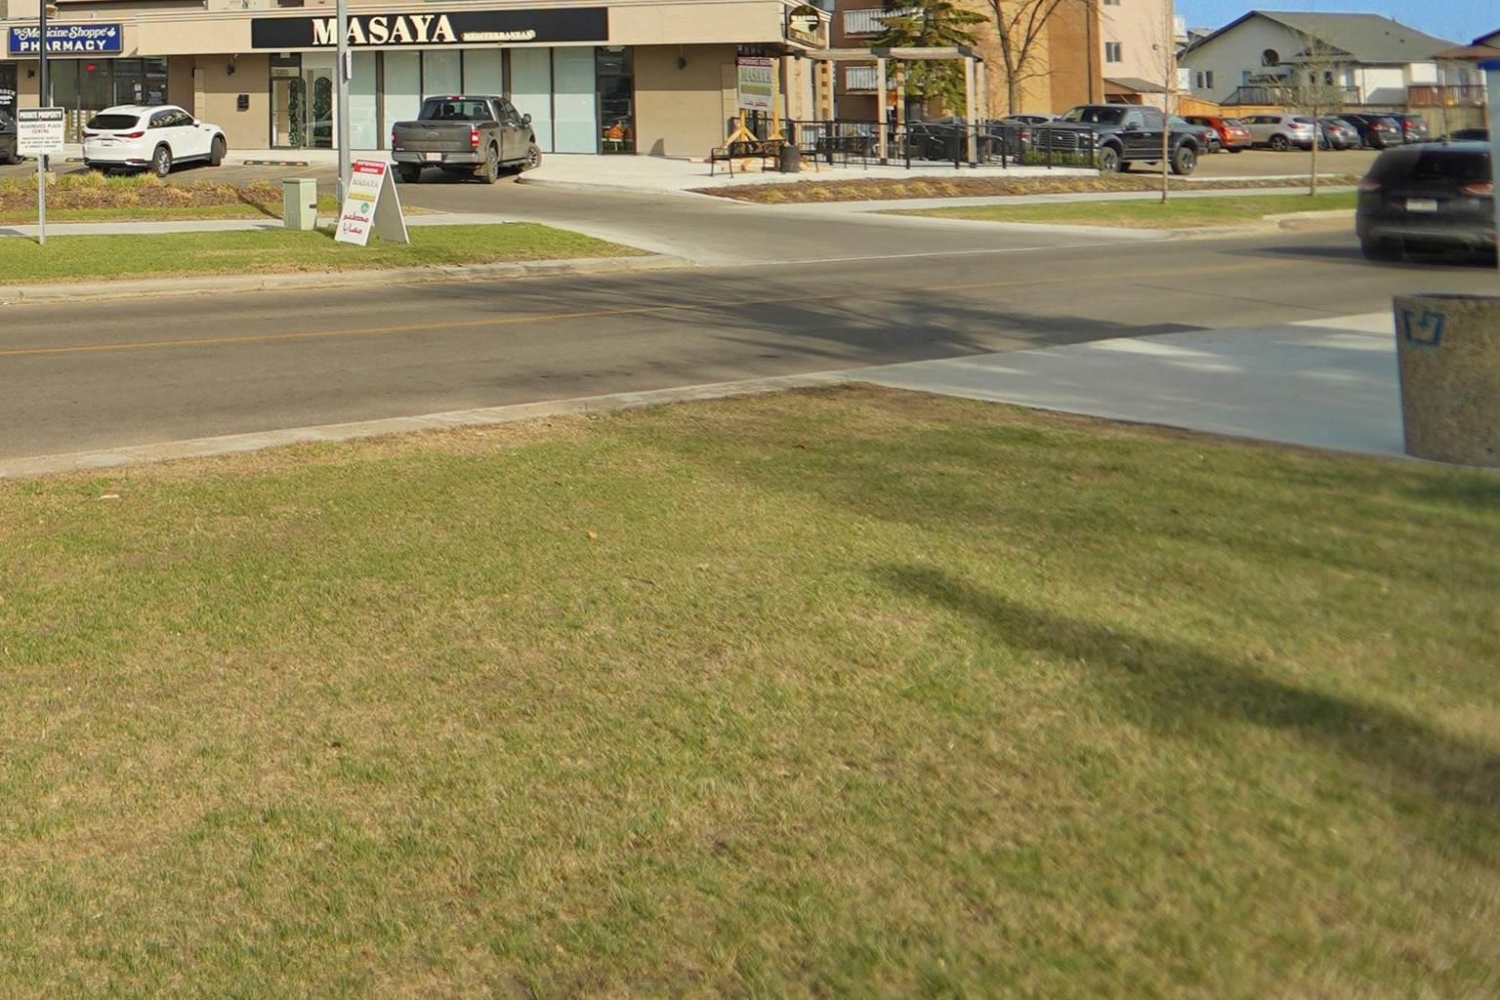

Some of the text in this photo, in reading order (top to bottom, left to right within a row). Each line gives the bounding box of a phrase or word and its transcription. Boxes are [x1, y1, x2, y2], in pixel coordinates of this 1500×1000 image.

[19, 27, 68, 40] Meicine
[69, 26, 106, 38] Shoppe
[312, 14, 457, 45] MASAYA
